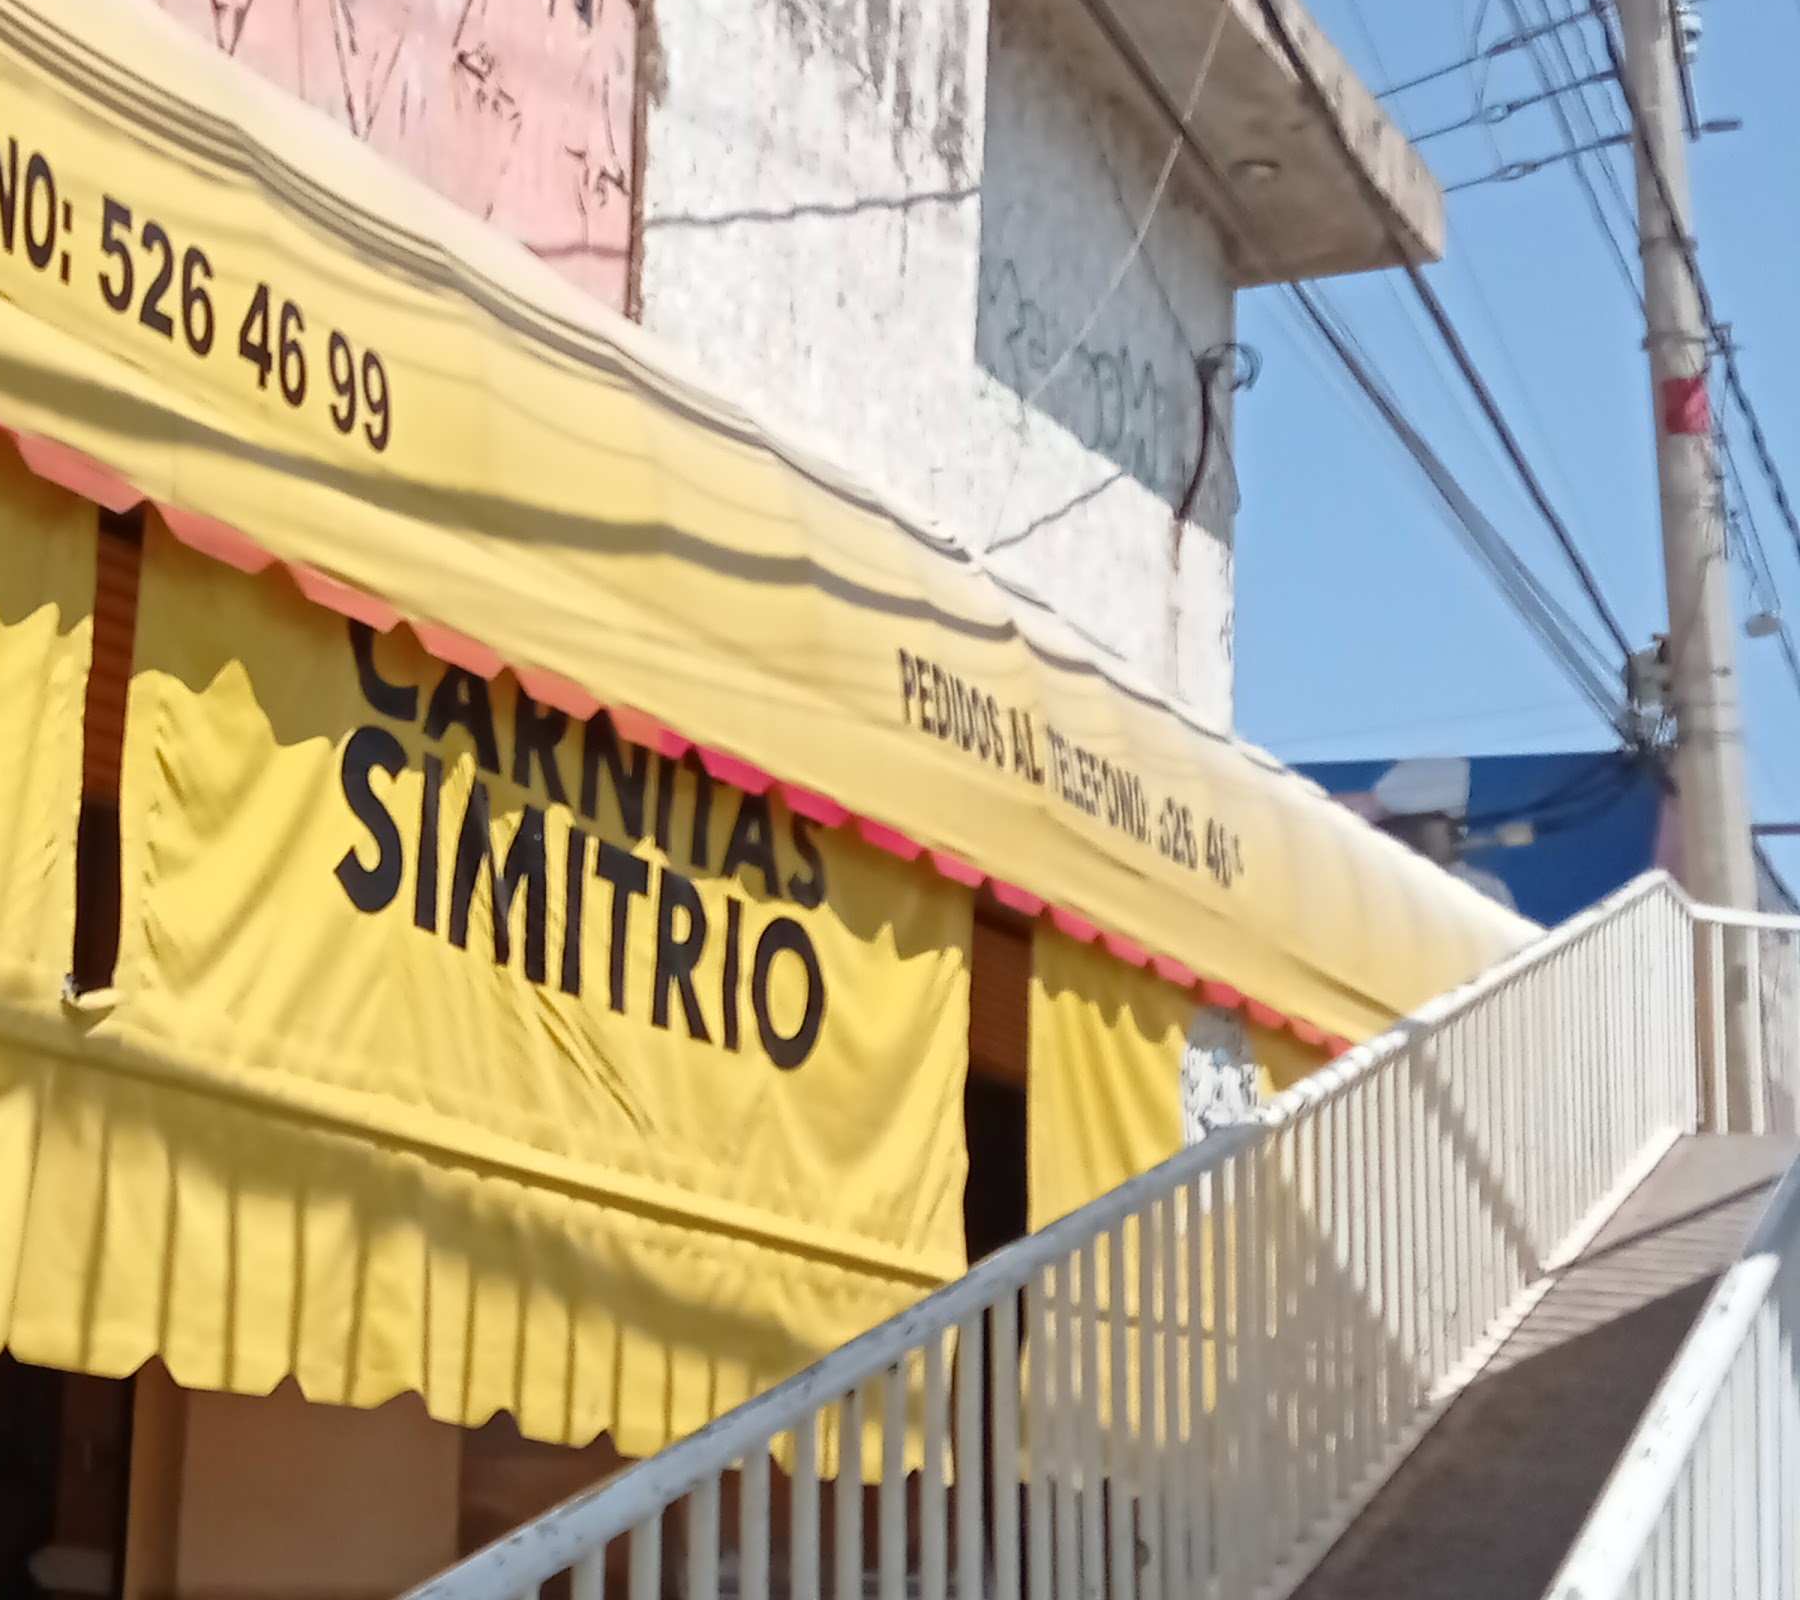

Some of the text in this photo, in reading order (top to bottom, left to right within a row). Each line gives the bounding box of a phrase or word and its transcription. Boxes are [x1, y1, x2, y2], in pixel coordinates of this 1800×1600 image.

[99, 194, 215, 357] 526
[239, 281, 307, 408] 46
[327, 330, 392, 453] 99
[348, 620, 826, 910] CARNITAS
[898, 647, 1004, 769] PEDIDOS
[1009, 706, 1046, 786] AL
[334, 725, 828, 1070] SIMITRIO
